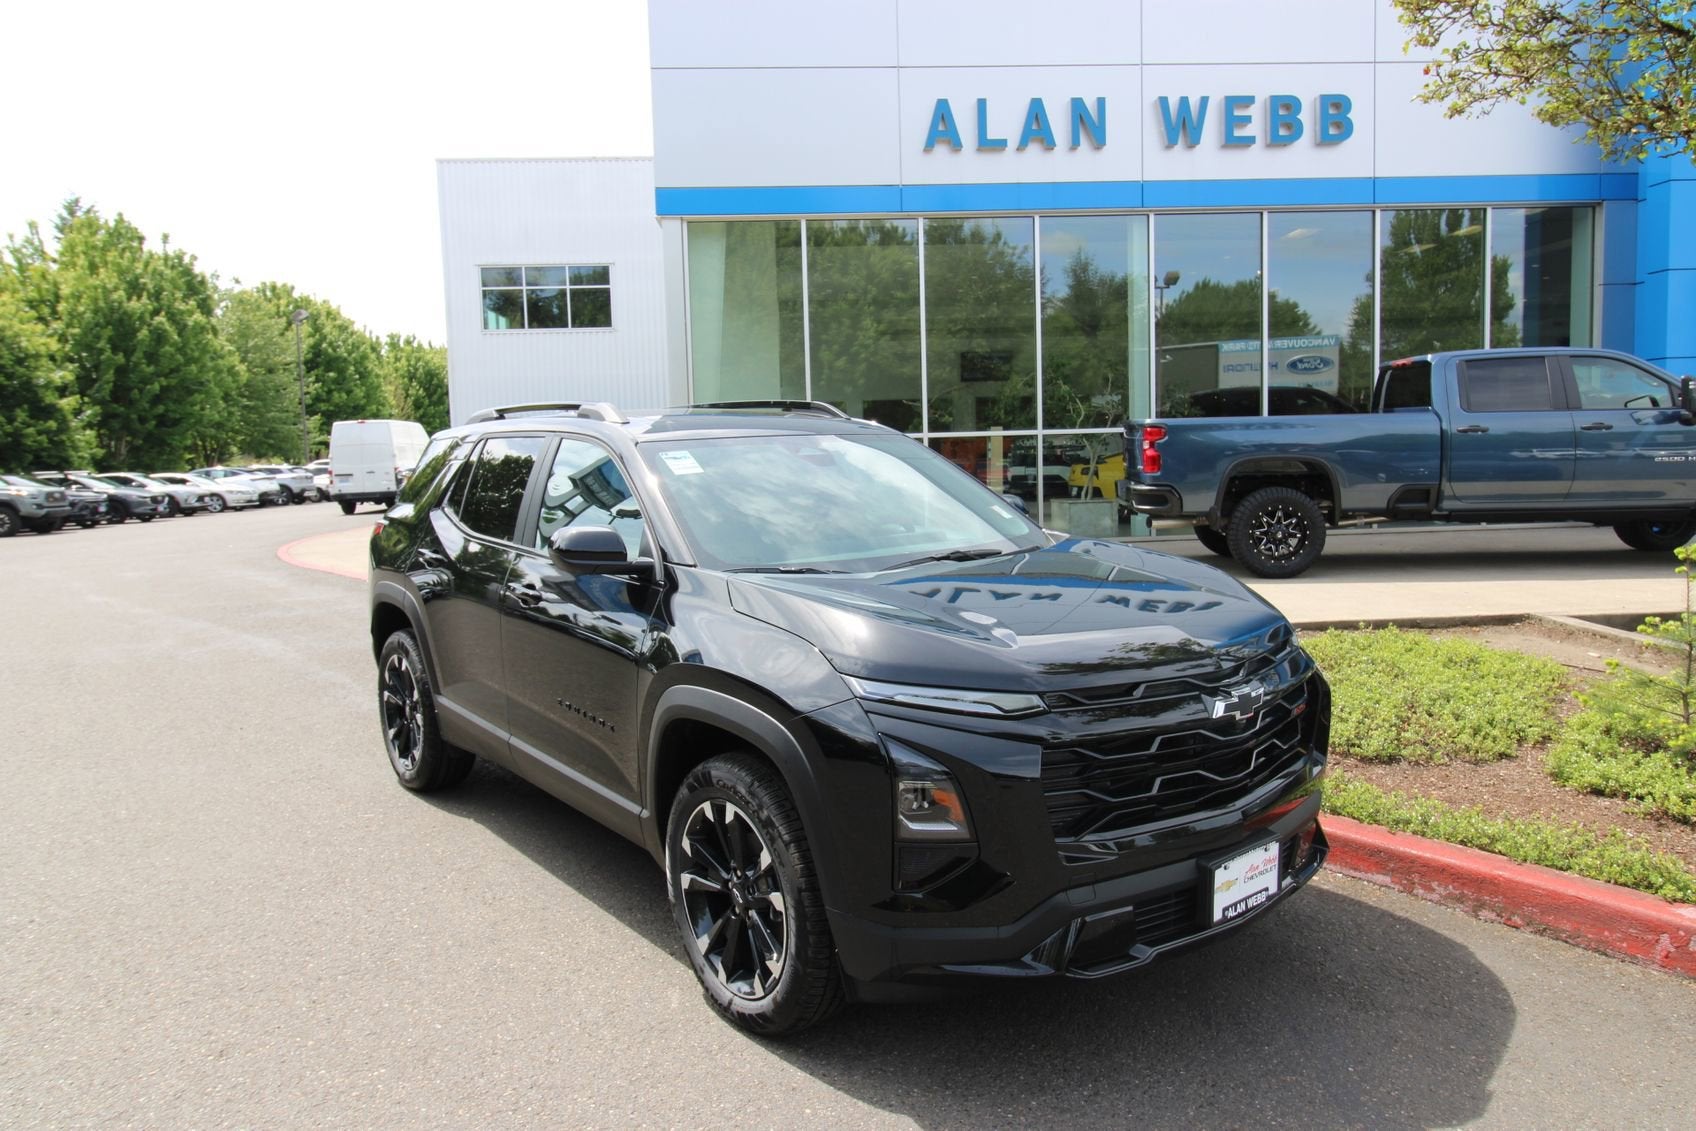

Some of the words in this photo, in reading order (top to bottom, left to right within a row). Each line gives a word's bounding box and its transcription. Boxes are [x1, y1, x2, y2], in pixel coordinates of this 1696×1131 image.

[923, 97, 1107, 151] ALAN
[1155, 93, 1354, 149] WEBB
[1243, 865, 1276, 883] CHEVROLET
[1228, 900, 1245, 918] ALAN
[1246, 892, 1266, 909] WEBB
